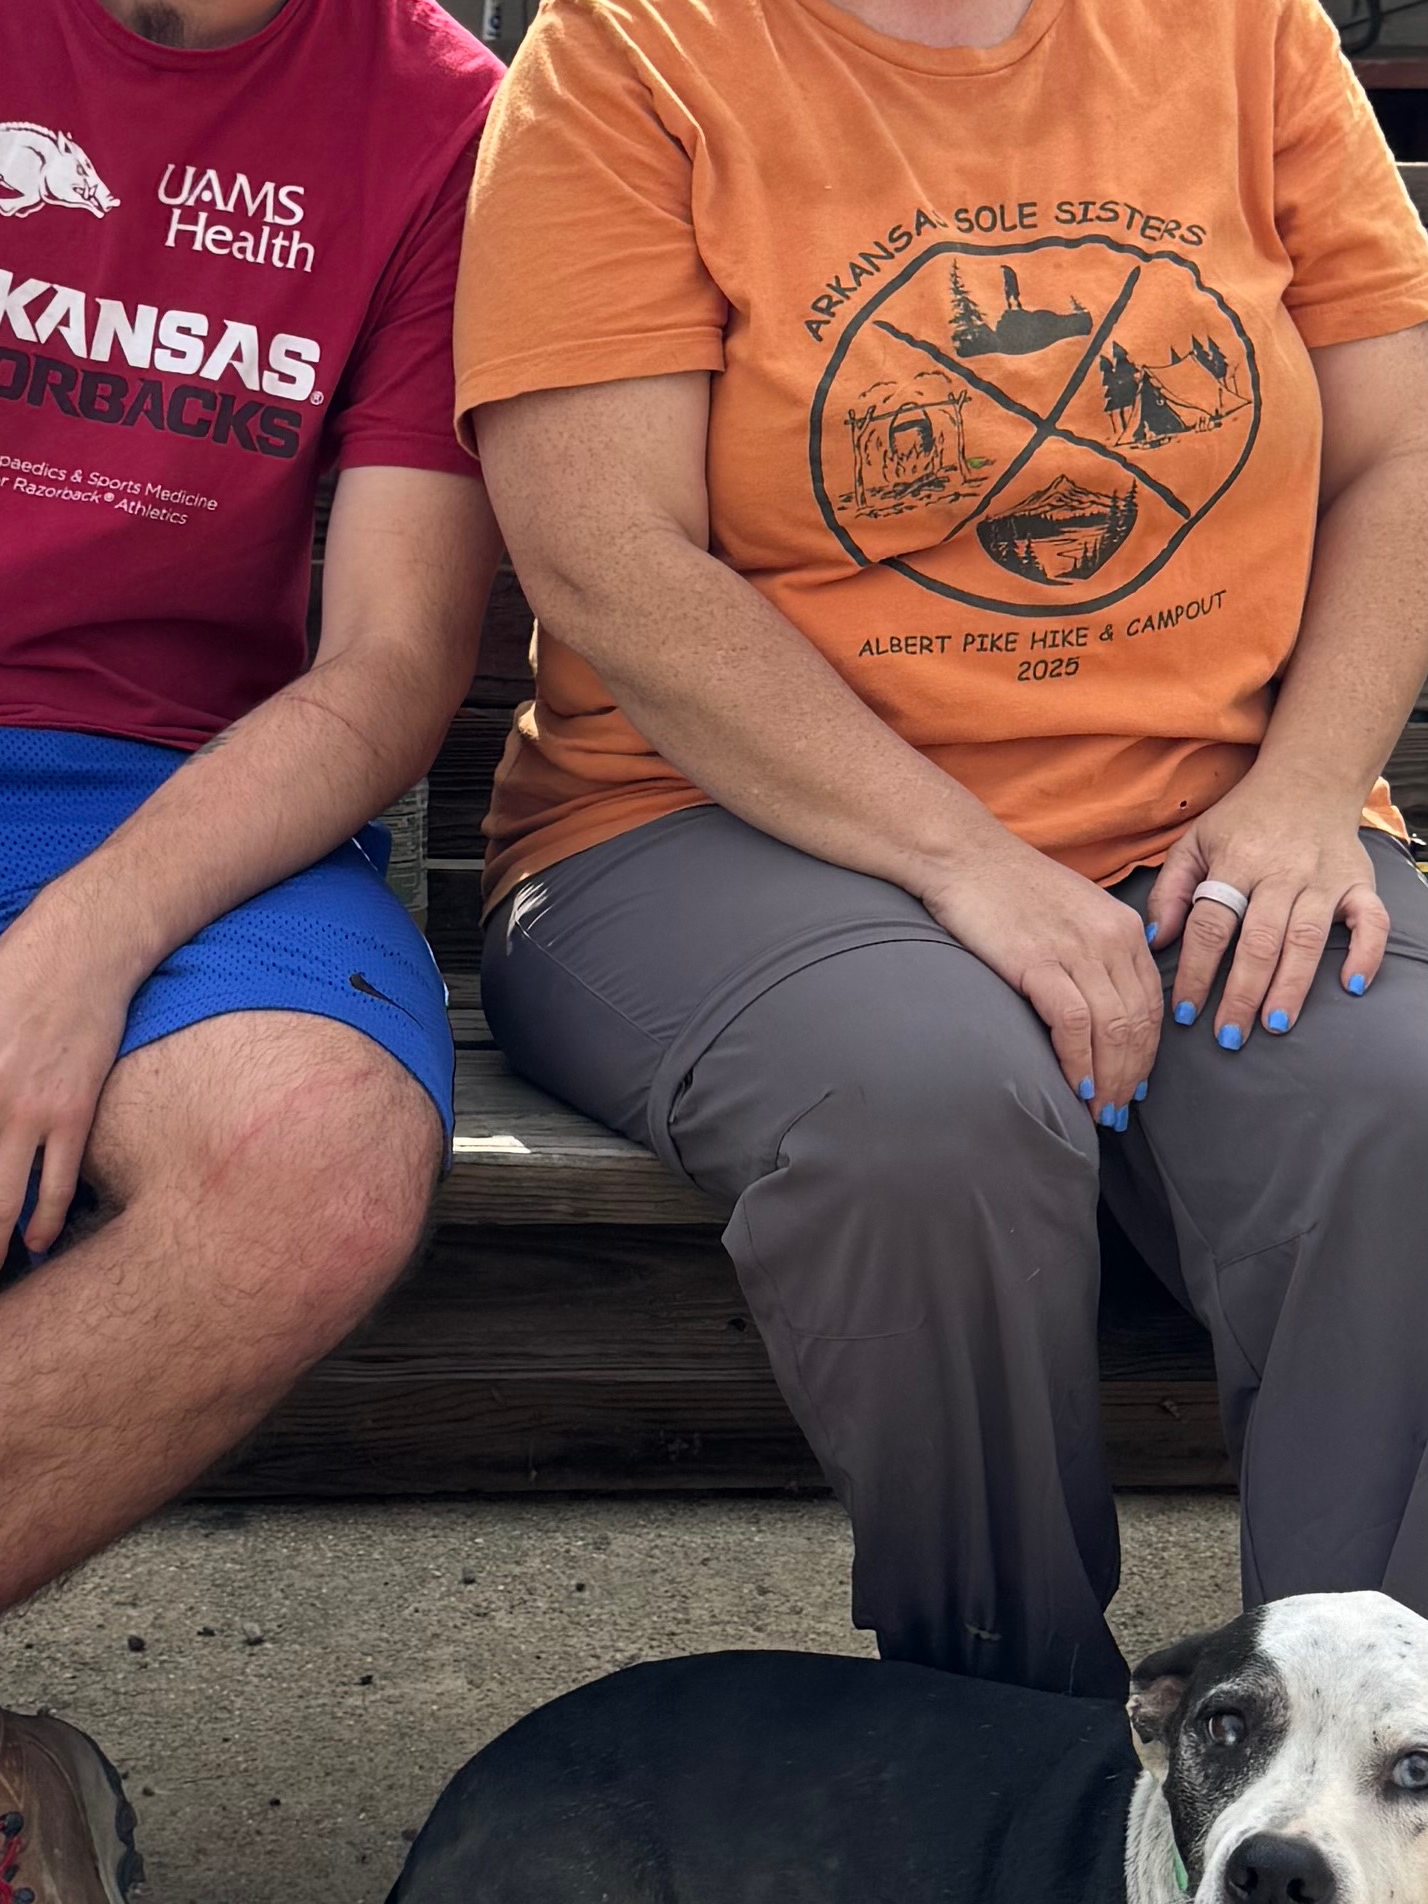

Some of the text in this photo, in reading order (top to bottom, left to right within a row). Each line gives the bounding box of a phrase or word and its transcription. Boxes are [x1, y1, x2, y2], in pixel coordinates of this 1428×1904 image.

[158, 163, 305, 226] UAMS
[164, 208, 315, 272] Health
[954, 201, 1039, 234] SOLE
[1055, 199, 1207, 247] SISTERS
[70, 468, 84, 484] &
[87, 471, 143, 495] Sports
[145, 482, 219, 511] Medicine
[114, 498, 189, 525] Athletics
[857, 589, 1227, 658] ALBERT PIKE HIKE & CAMPOUT
[1017, 656, 1081, 682] 2025
